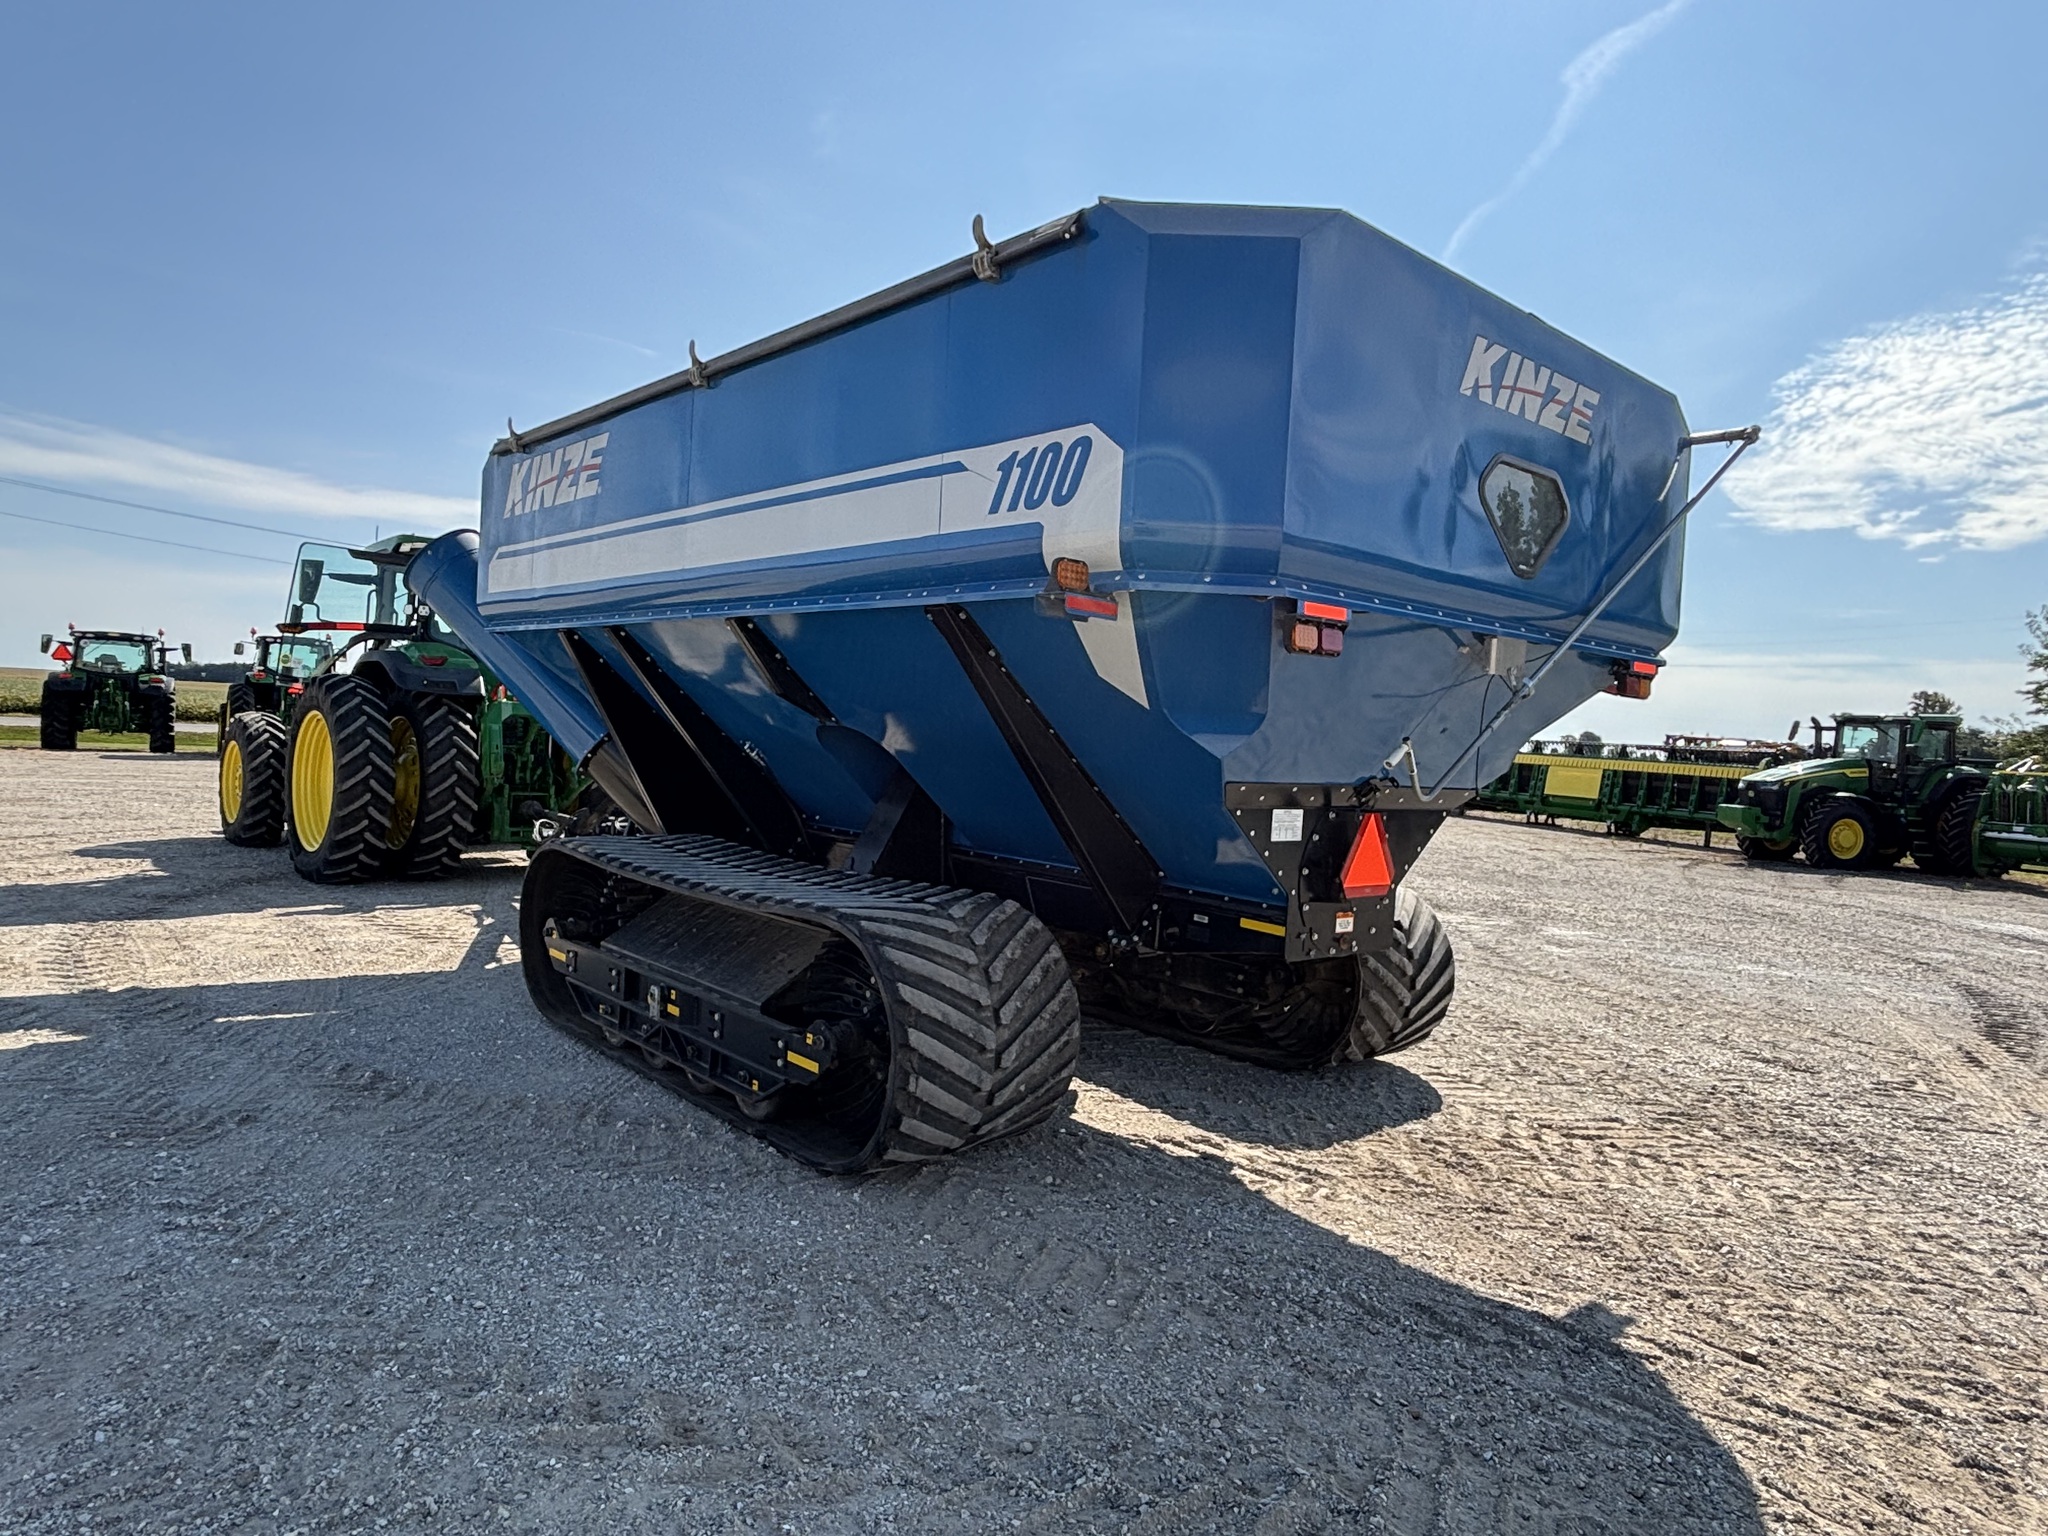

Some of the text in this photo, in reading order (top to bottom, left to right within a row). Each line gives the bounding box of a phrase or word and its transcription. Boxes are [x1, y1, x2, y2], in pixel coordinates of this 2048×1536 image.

[1460, 336, 1600, 444] KINZE
[503, 432, 610, 519] KINZE
[988, 435, 1093, 515] 1100
